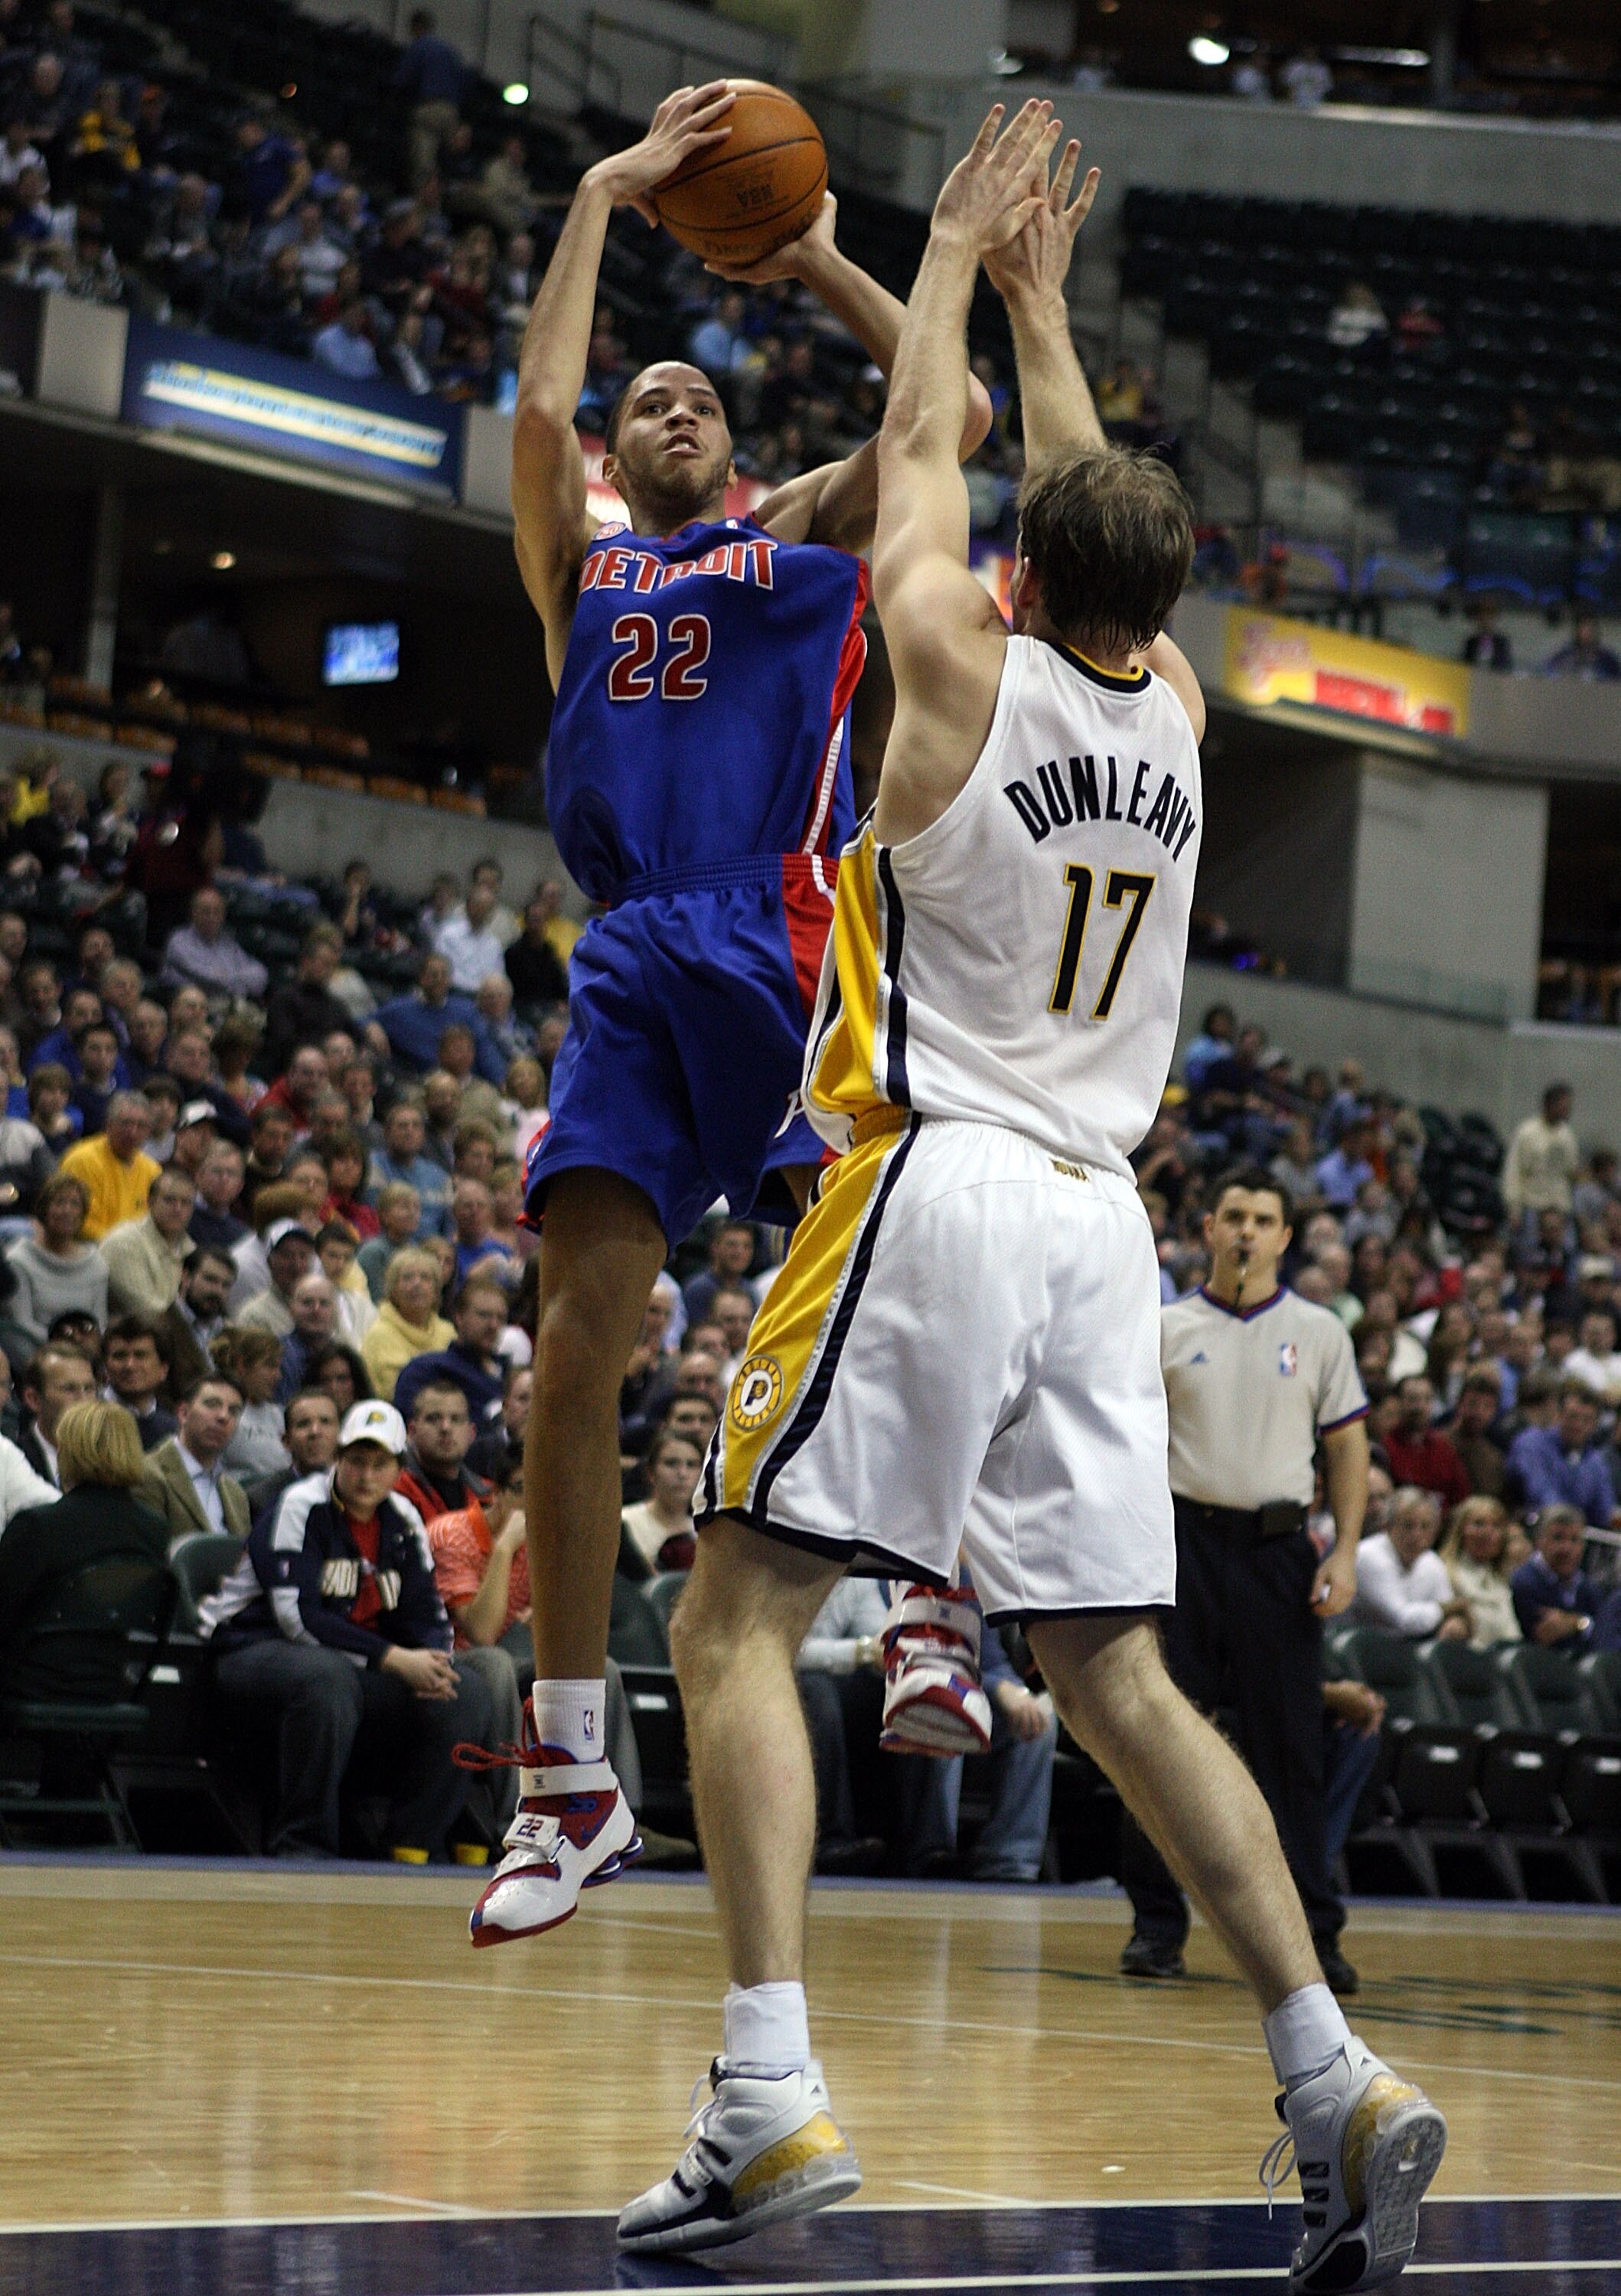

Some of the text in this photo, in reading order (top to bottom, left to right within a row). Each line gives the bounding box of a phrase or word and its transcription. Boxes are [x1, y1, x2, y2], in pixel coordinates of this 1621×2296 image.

[580, 539, 778, 594] DETROIT
[608, 612, 711, 701] 22
[1003, 755, 1196, 863] DUNLEAVY
[1048, 863, 1157, 1021] 17
[516, 1817, 544, 1838] 22
